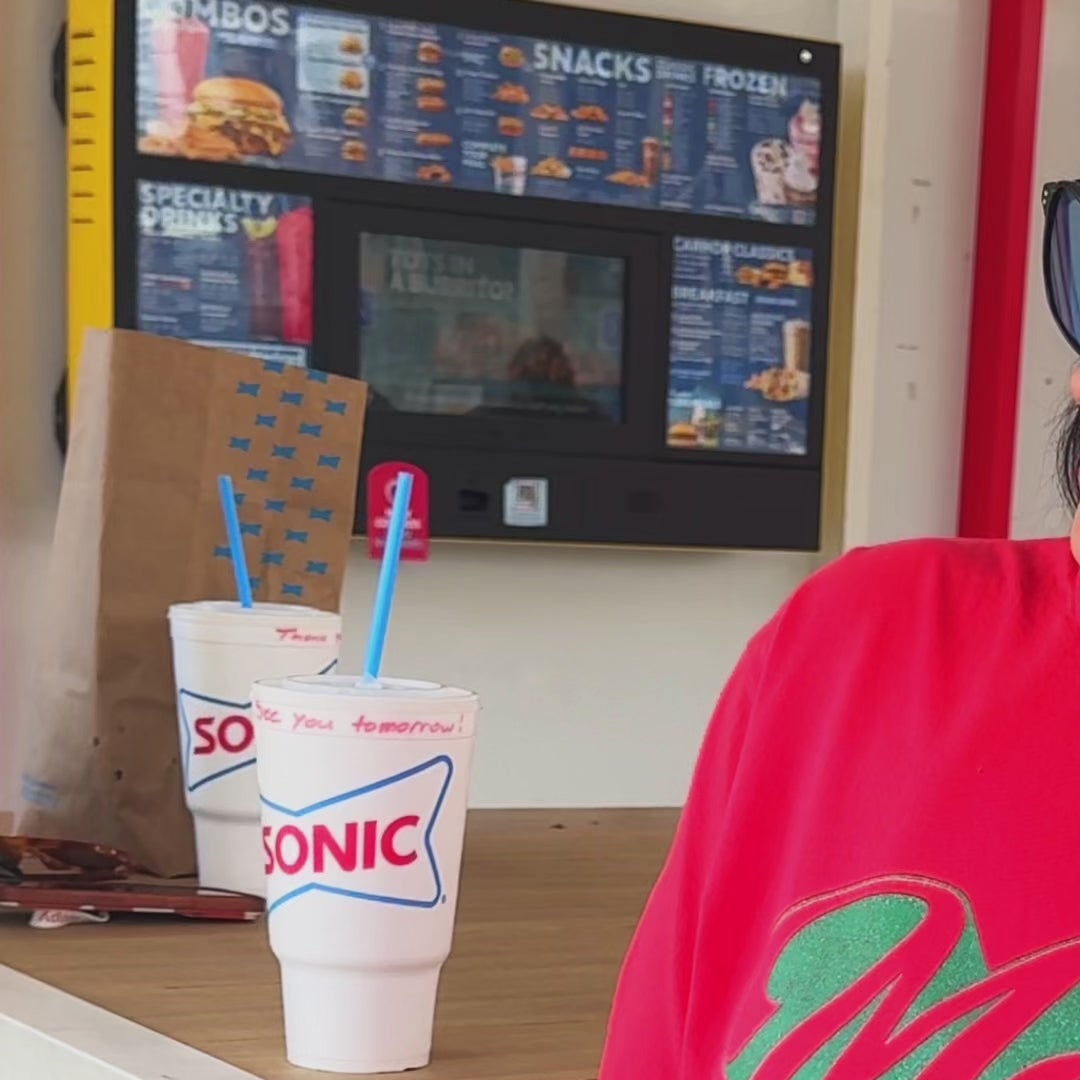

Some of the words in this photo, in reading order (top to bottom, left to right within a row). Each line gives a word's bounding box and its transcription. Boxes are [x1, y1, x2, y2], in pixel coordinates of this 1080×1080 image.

[533, 43, 651, 83] SNACKS
[702, 65, 789, 97] FROZEN
[140, 183, 274, 215] SPECIALTY
[351, 713, 464, 734] tomorrow!
